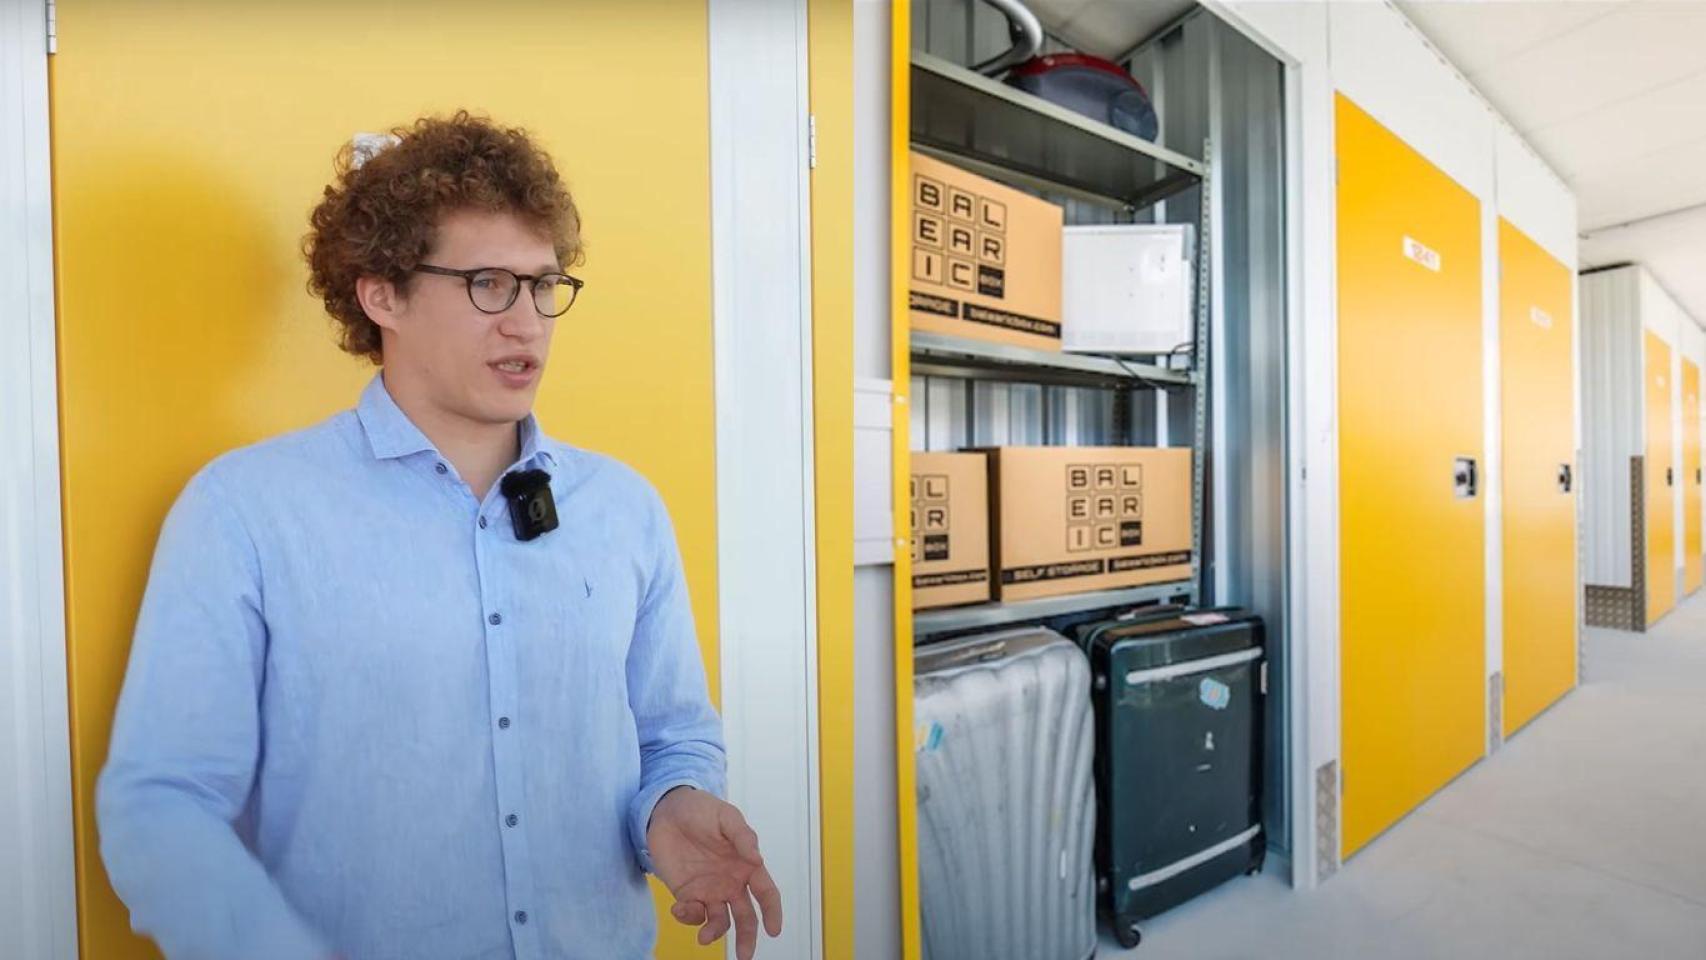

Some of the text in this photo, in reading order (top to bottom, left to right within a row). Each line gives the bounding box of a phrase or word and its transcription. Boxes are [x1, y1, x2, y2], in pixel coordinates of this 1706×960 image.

[920, 182, 1001, 227] BAL
[920, 218, 1001, 260] EAR
[926, 255, 971, 286] IC
[1071, 469, 1137, 487] BAL
[1071, 497, 1138, 516] EAR
[1077, 527, 1113, 546] IC
[1014, 562, 1099, 580] SELF STORAGE
